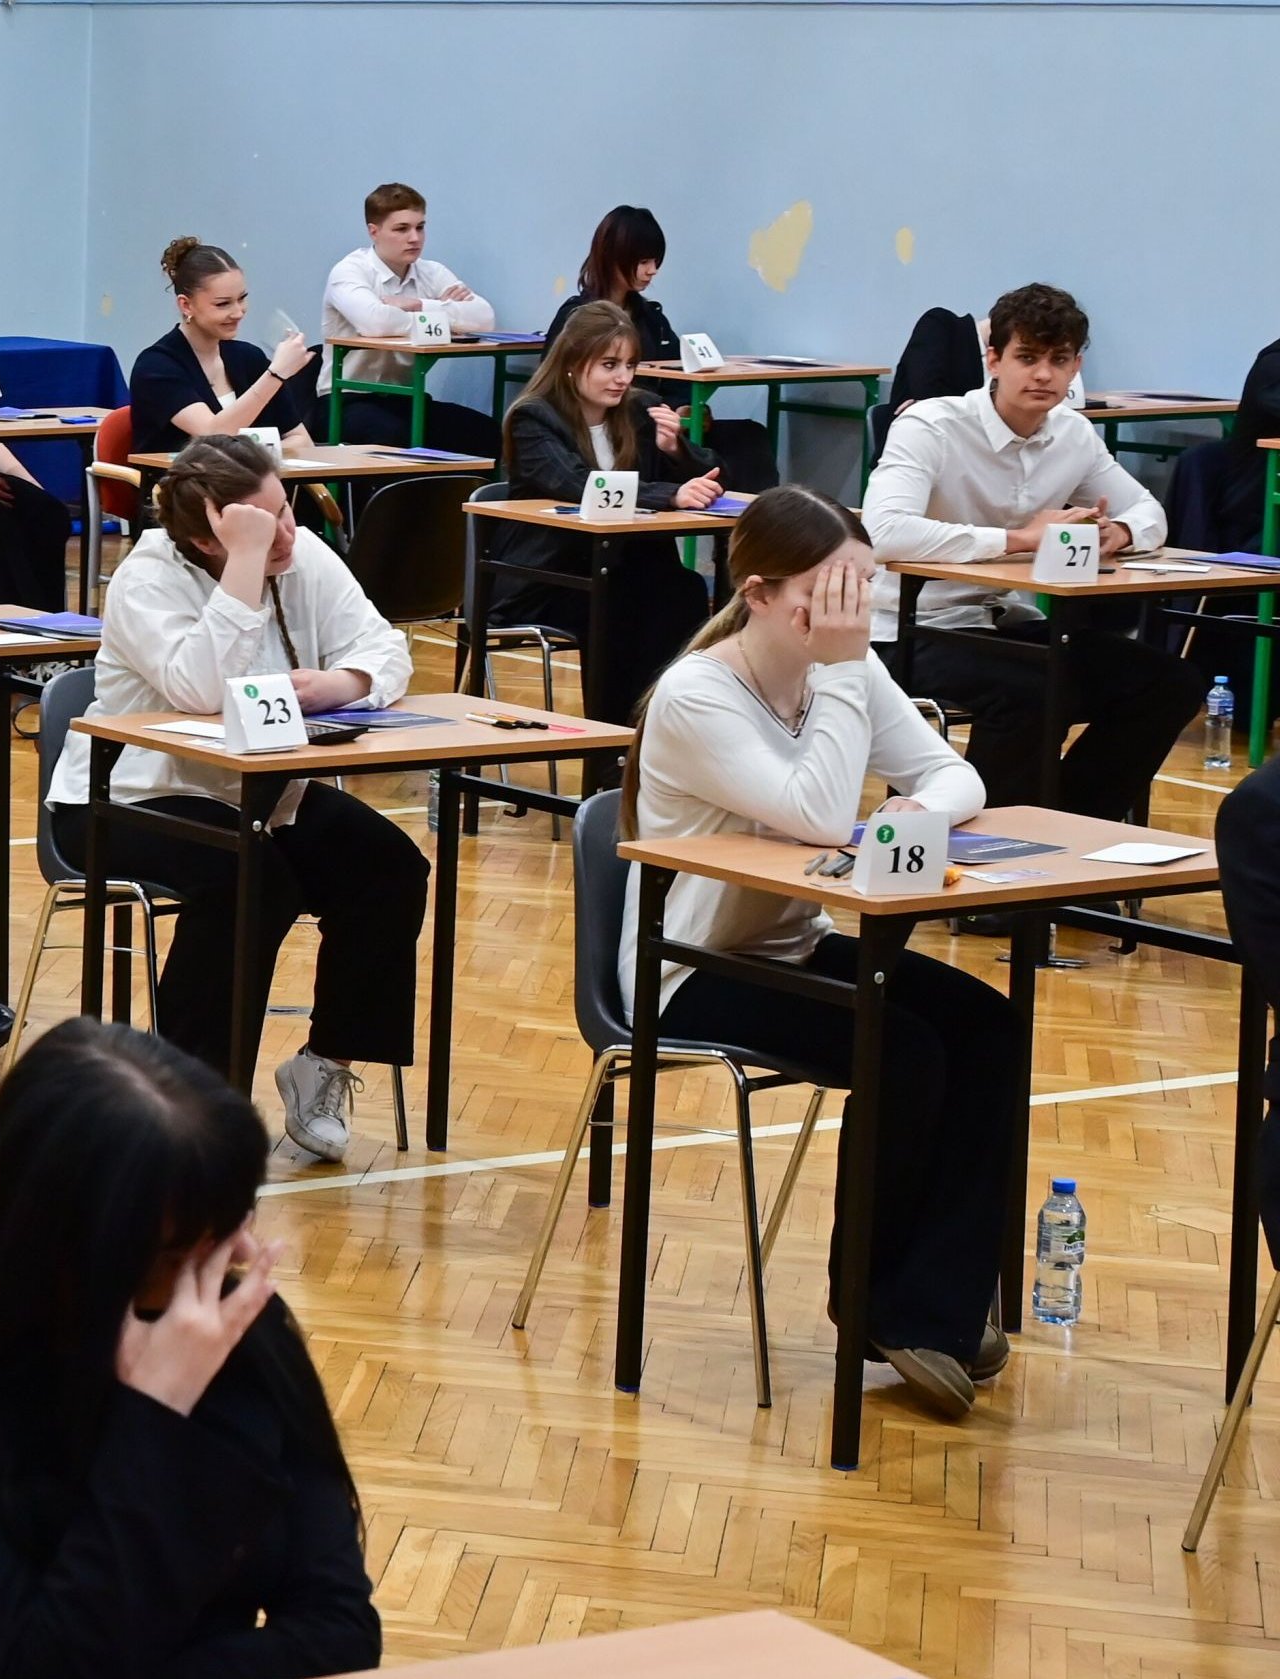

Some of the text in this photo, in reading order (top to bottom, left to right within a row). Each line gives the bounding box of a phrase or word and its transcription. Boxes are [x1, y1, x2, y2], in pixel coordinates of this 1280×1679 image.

[424, 322, 443, 337] 46
[697, 345, 713, 359] 41
[597, 489, 624, 509] 32
[1065, 544, 1092, 567] 27
[257, 697, 292, 726] 23
[888, 844, 925, 874] 18
